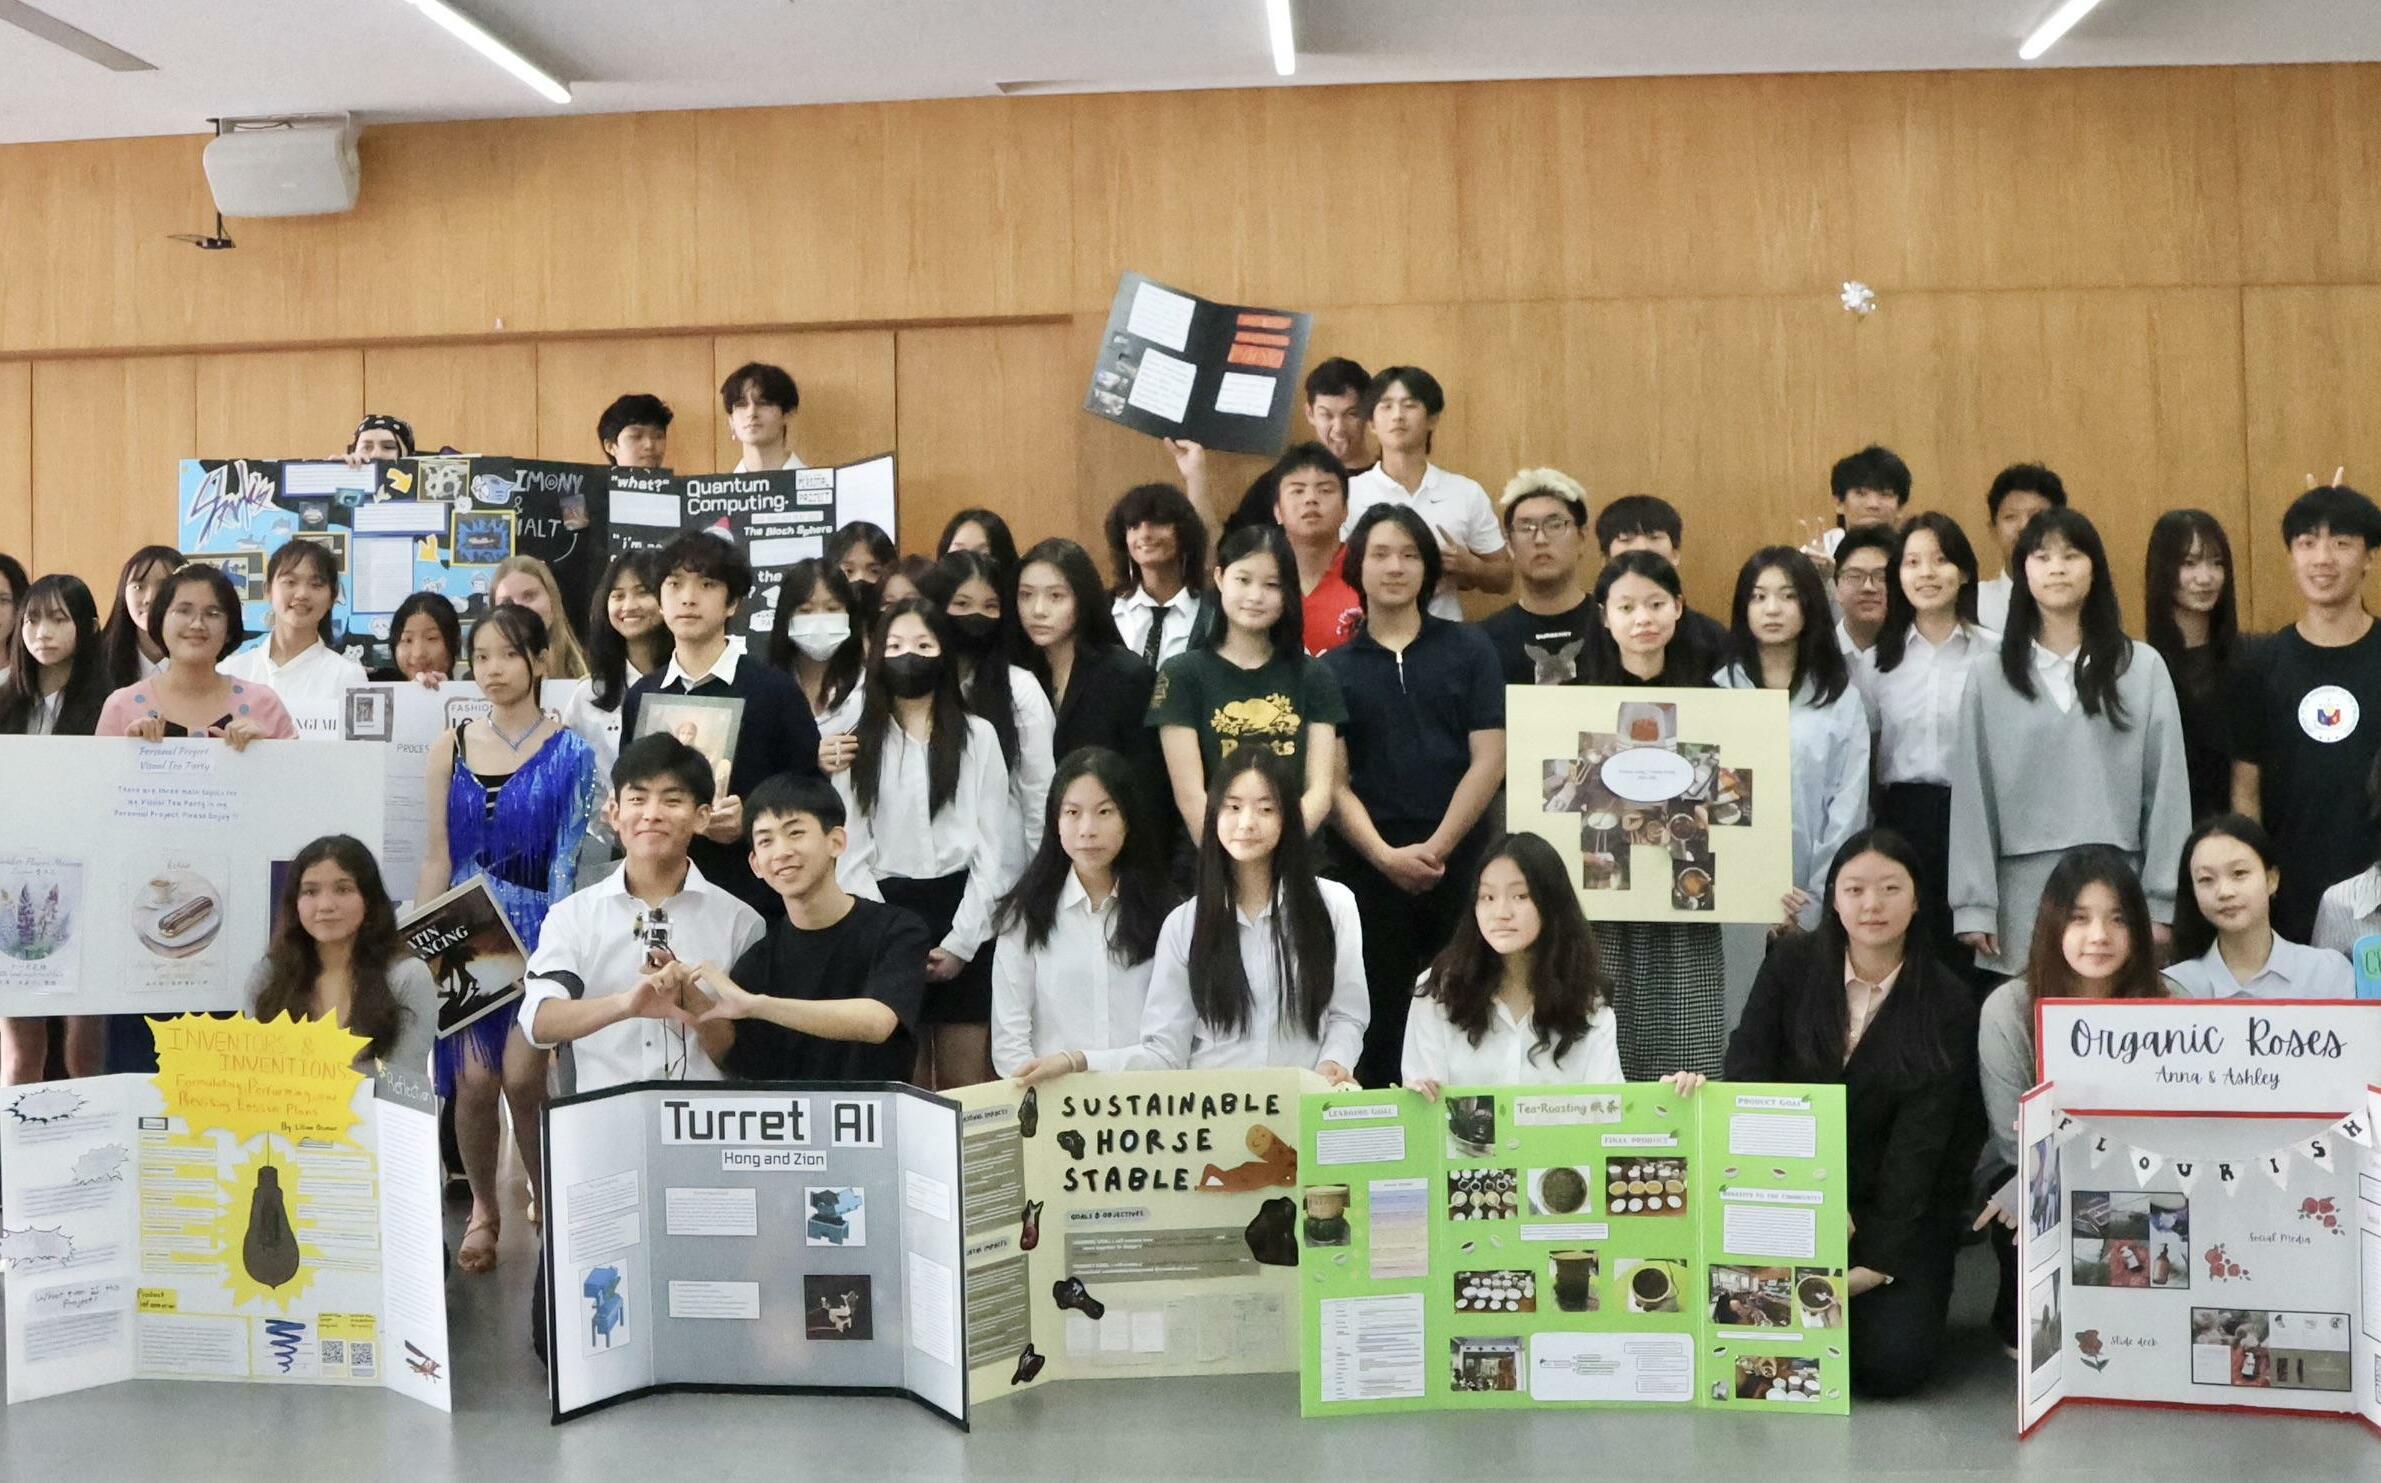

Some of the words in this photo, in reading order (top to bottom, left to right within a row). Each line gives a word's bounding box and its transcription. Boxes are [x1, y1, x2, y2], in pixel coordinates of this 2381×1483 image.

[687, 477, 770, 498] Quantum
[687, 494, 789, 516] Computing.
[744, 526, 763, 537] The
[765, 525, 795, 537] Bloch
[796, 524, 833, 538] Sphere
[758, 570, 783, 583] the
[1220, 739, 1295, 760] Rts
[420, 925, 469, 959] NCING
[167, 1027, 287, 1054] INVENTORS
[2070, 1018, 2224, 1064] Organic
[2246, 1016, 2347, 1059] Roses
[219, 1054, 347, 1081] INVENTIONS
[2156, 1065, 2202, 1085] Anna
[2208, 1070, 2216, 1084] &
[2223, 1066, 2280, 1090] Ashley
[286, 1103, 319, 1116] Plans
[1062, 1092, 1280, 1119] SUSTAINABLE
[664, 1100, 804, 1142] Turret
[834, 1103, 875, 1143] AI
[1097, 1128, 1213, 1156] HORSE
[724, 1152, 761, 1167] Hong
[764, 1153, 790, 1166] and
[793, 1152, 825, 1167] Zion
[1063, 1166, 1189, 1192] STABLE
[1102, 1210, 1144, 1219] OBJECTIVES
